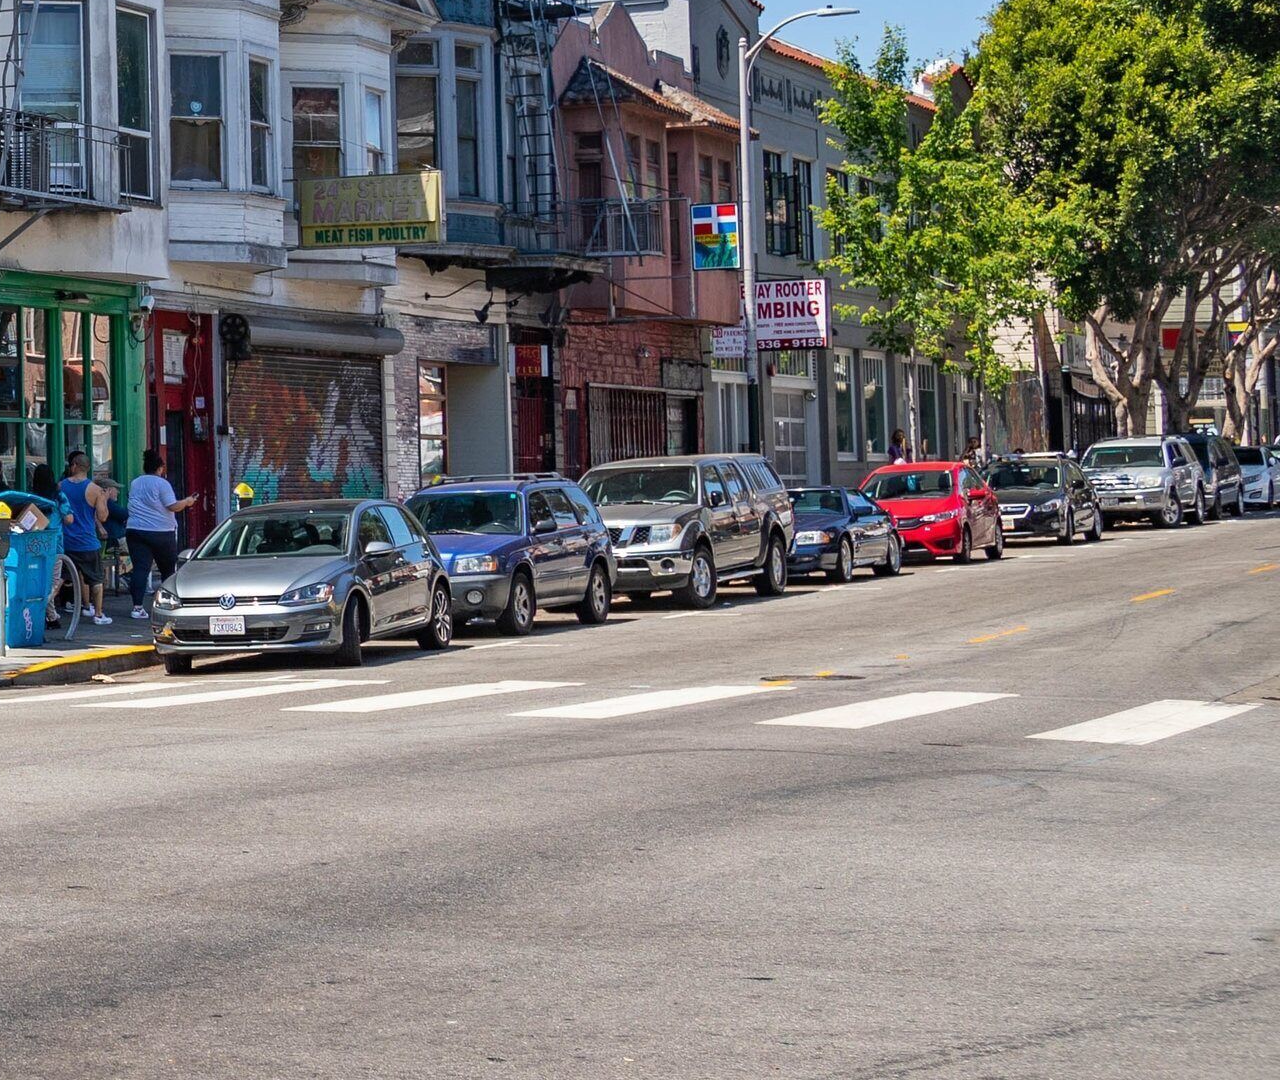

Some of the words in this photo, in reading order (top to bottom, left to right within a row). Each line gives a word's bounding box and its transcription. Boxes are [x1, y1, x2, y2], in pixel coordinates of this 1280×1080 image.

[357, 178, 419, 199] STREE
[312, 200, 426, 223] MARKET
[315, 229, 344, 243] MEAT
[348, 228, 373, 242] FISH
[378, 226, 427, 241] POULTRY
[740, 282, 771, 300] EAY
[776, 281, 822, 299] ROOTER
[758, 339, 781, 348] 336
[792, 338, 823, 348] 9155
